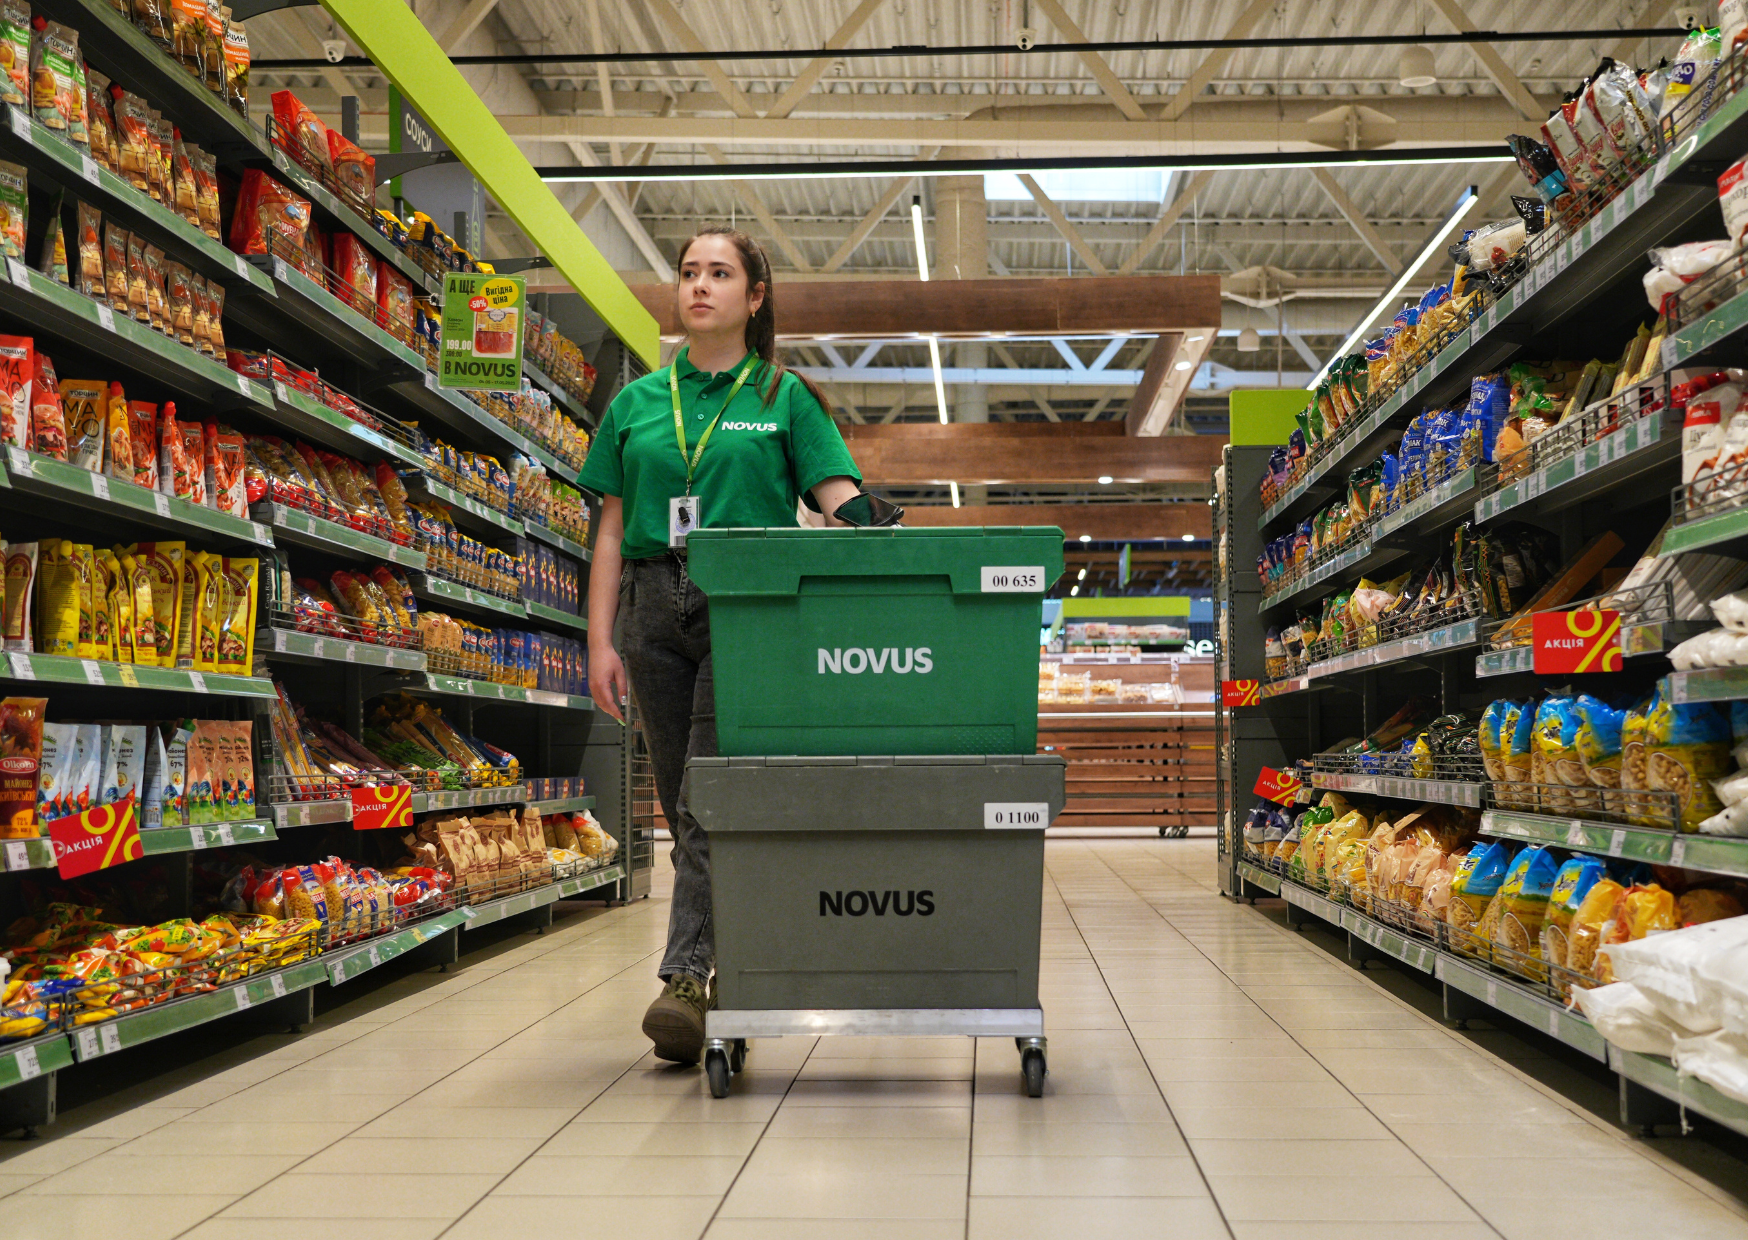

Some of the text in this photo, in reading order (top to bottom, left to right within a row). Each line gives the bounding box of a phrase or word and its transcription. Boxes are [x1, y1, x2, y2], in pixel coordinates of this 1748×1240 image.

[405, 112, 431, 151] СОУСИ
[449, 279, 476, 295] А ЩЕ
[485, 285, 513, 296] Вигідна
[493, 295, 508, 305] ціна
[446, 339, 472, 350] 199.00
[444, 360, 516, 377] В NOVUS
[63, 400, 97, 418] MA
[674, 409, 682, 427] NOVUS
[68, 418, 100, 438] YO
[721, 421, 778, 432] NOVUS
[692, 445, 704, 467] NOVUS
[992, 575, 1037, 588] 00 635
[1544, 638, 1584, 649] АКЦІЯ
[817, 647, 933, 674] NOVUS
[2, 760, 35, 769] Olkom
[4, 778, 33, 788] МАЙОНЕЗ
[1262, 780, 1282, 791] АКЦІЯ
[360, 803, 387, 811] АКЦІЯ
[995, 811, 1040, 824] 0 1100
[66, 836, 103, 854] АКЦІЯ
[819, 890, 935, 916] NOVUS
